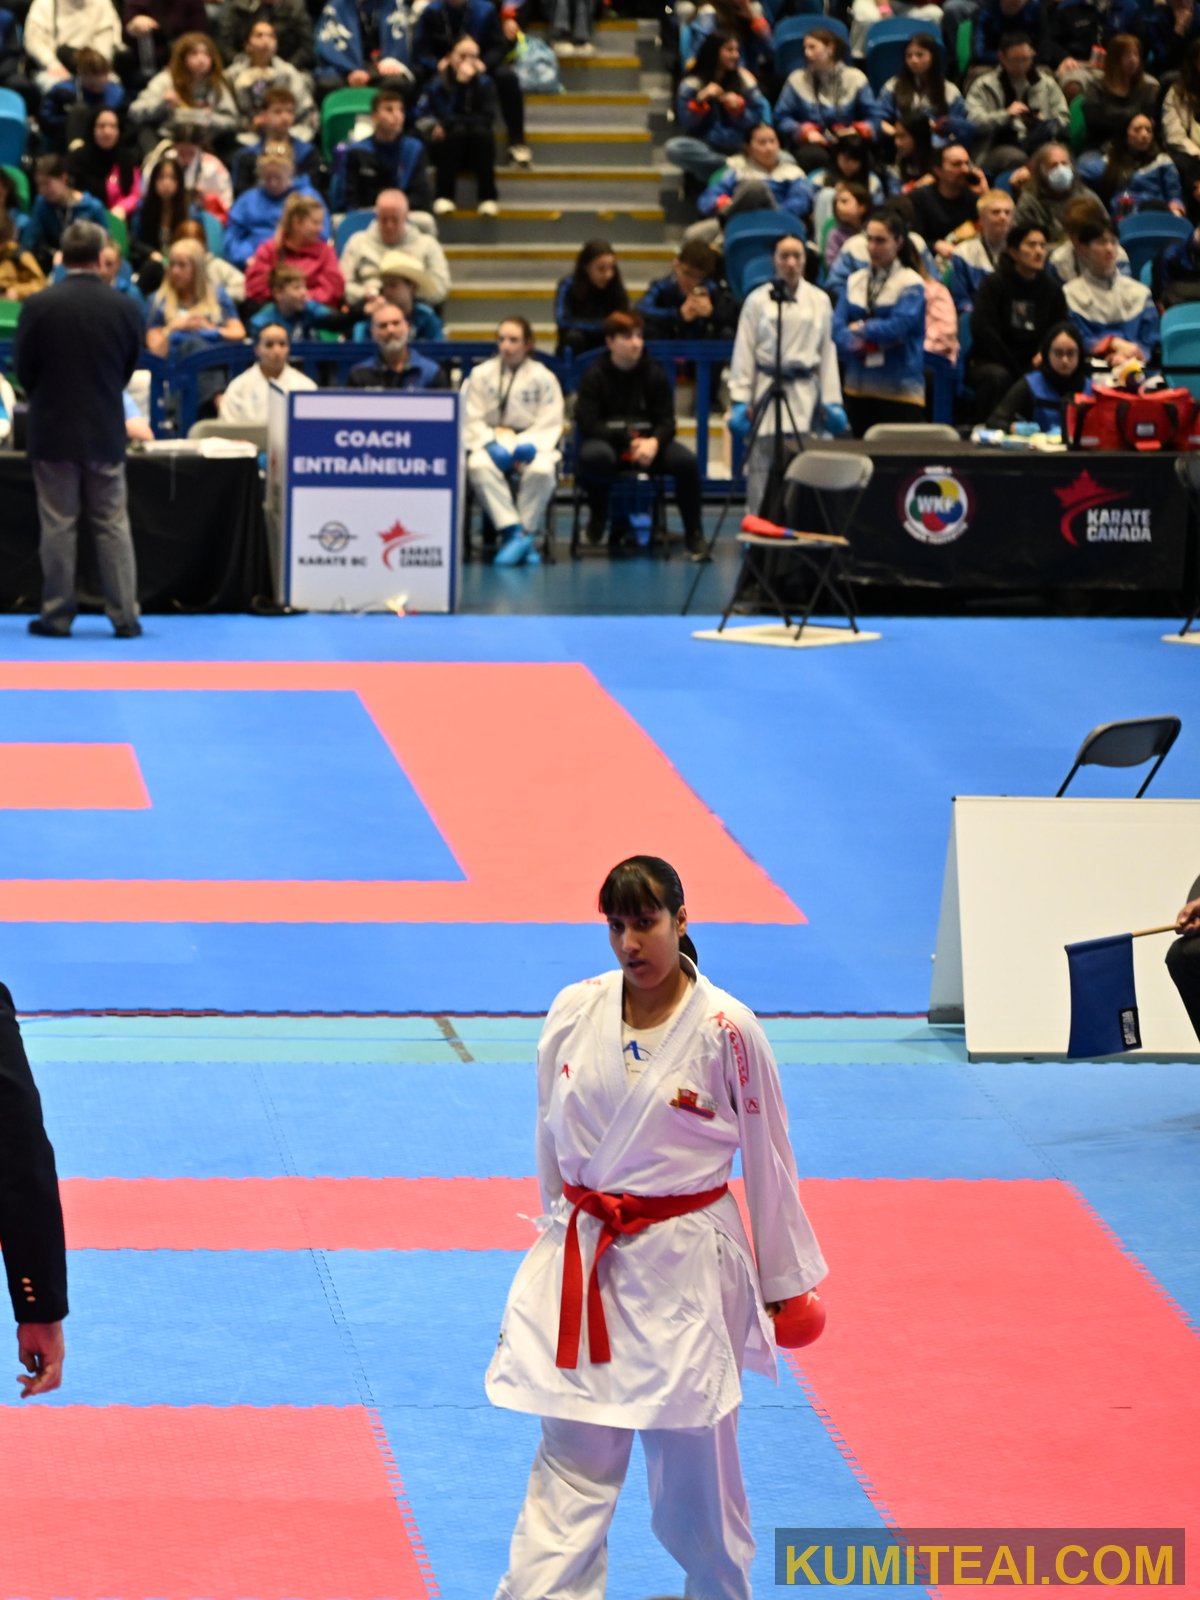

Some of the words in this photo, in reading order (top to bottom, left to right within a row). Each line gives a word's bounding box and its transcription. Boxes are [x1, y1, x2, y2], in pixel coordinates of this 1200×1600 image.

[335, 430, 411, 448] COACH
[917, 496, 956, 514] WKF
[1087, 508, 1150, 526] KARATE
[1087, 527, 1151, 542] CANADA
[400, 546, 442, 556] KARATE
[298, 557, 346, 567] KARATE
[400, 557, 443, 567] CANADA
